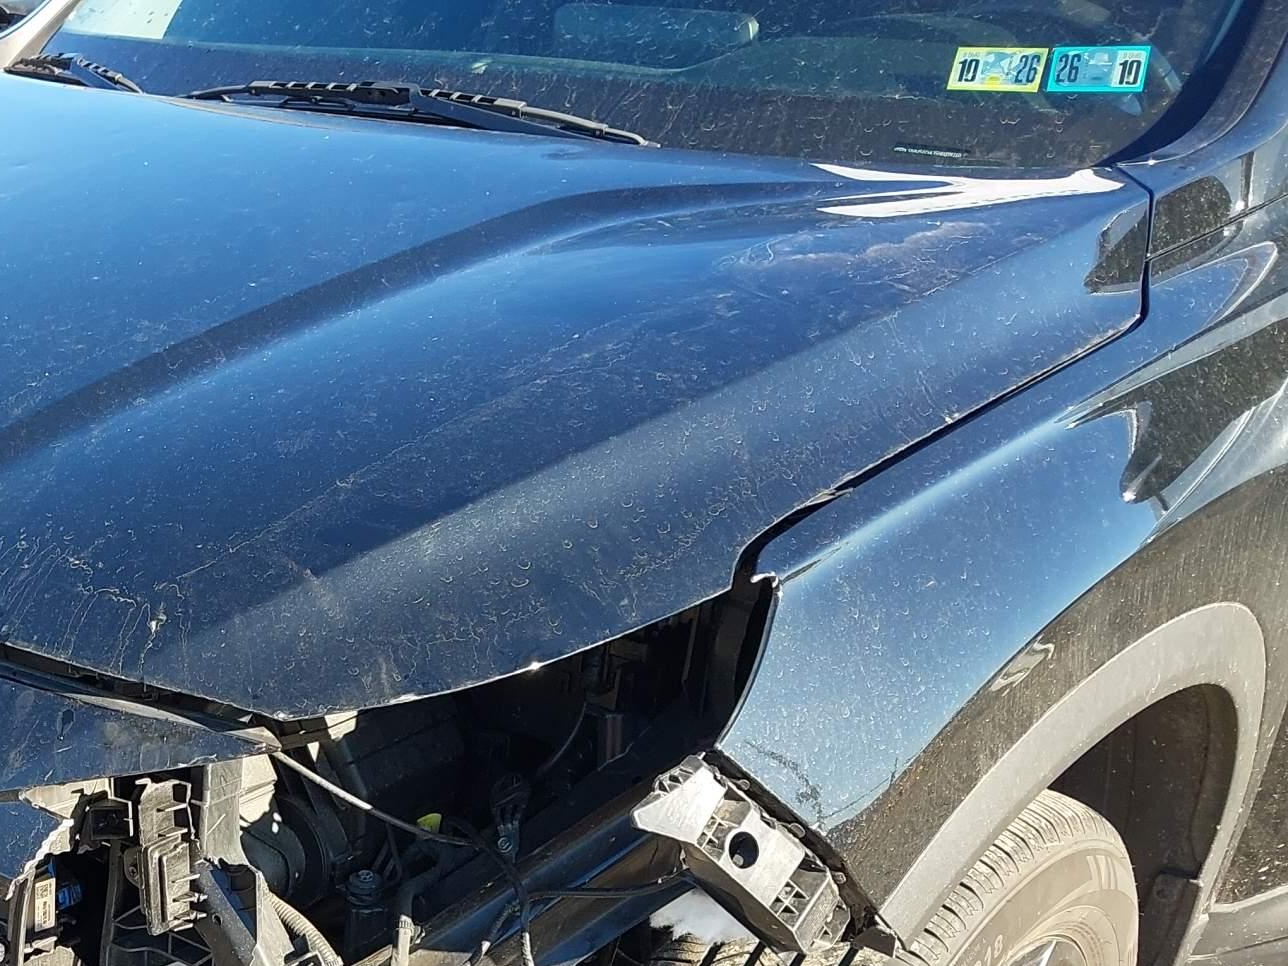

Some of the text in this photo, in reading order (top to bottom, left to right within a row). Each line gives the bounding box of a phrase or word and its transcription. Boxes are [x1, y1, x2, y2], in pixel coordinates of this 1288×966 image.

[957, 54, 1040, 84] 10 26
[1056, 53, 1142, 85] 26 10
